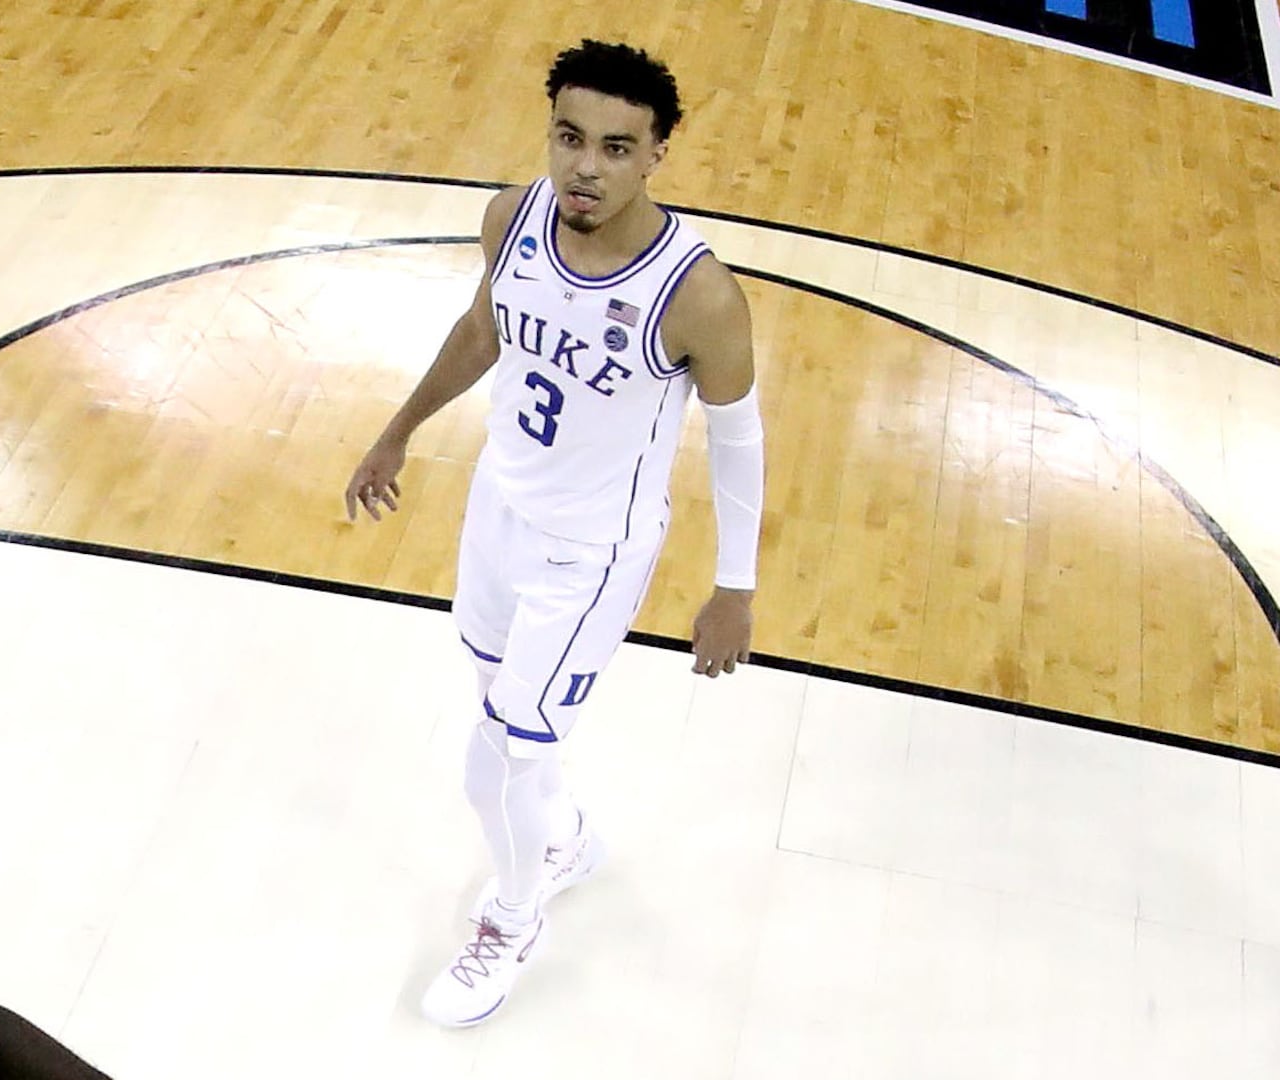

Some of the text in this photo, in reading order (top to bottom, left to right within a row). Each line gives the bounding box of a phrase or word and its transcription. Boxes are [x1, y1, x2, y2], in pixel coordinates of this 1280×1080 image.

[495, 302, 633, 397] DUKE
[518, 371, 565, 447] 3
[558, 671, 598, 706] D
